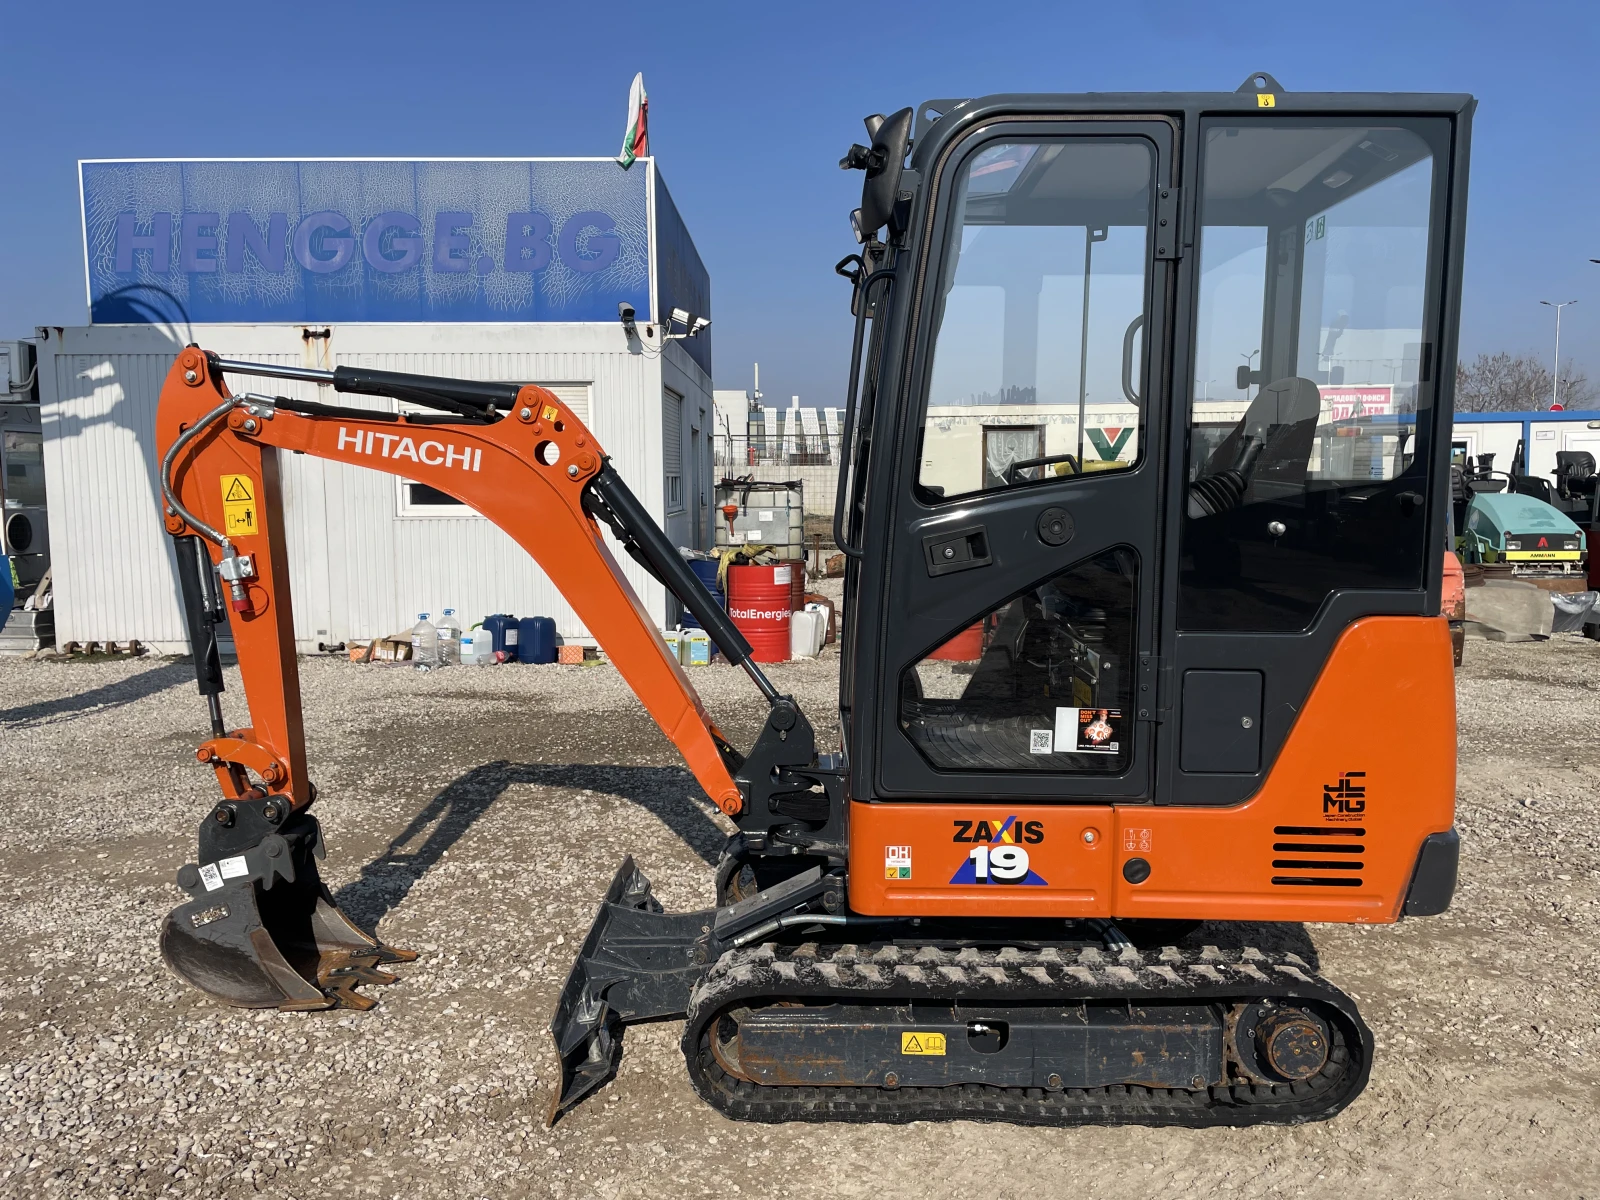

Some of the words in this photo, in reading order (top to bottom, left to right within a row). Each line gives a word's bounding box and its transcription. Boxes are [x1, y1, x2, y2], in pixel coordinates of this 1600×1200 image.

[114, 211, 621, 274] HENGGE.BG
[337, 426, 482, 473] HITACHI
[730, 608, 791, 621] TotalEnergies
[952, 816, 1045, 844] ZAXIS
[969, 845, 1030, 884] 19
